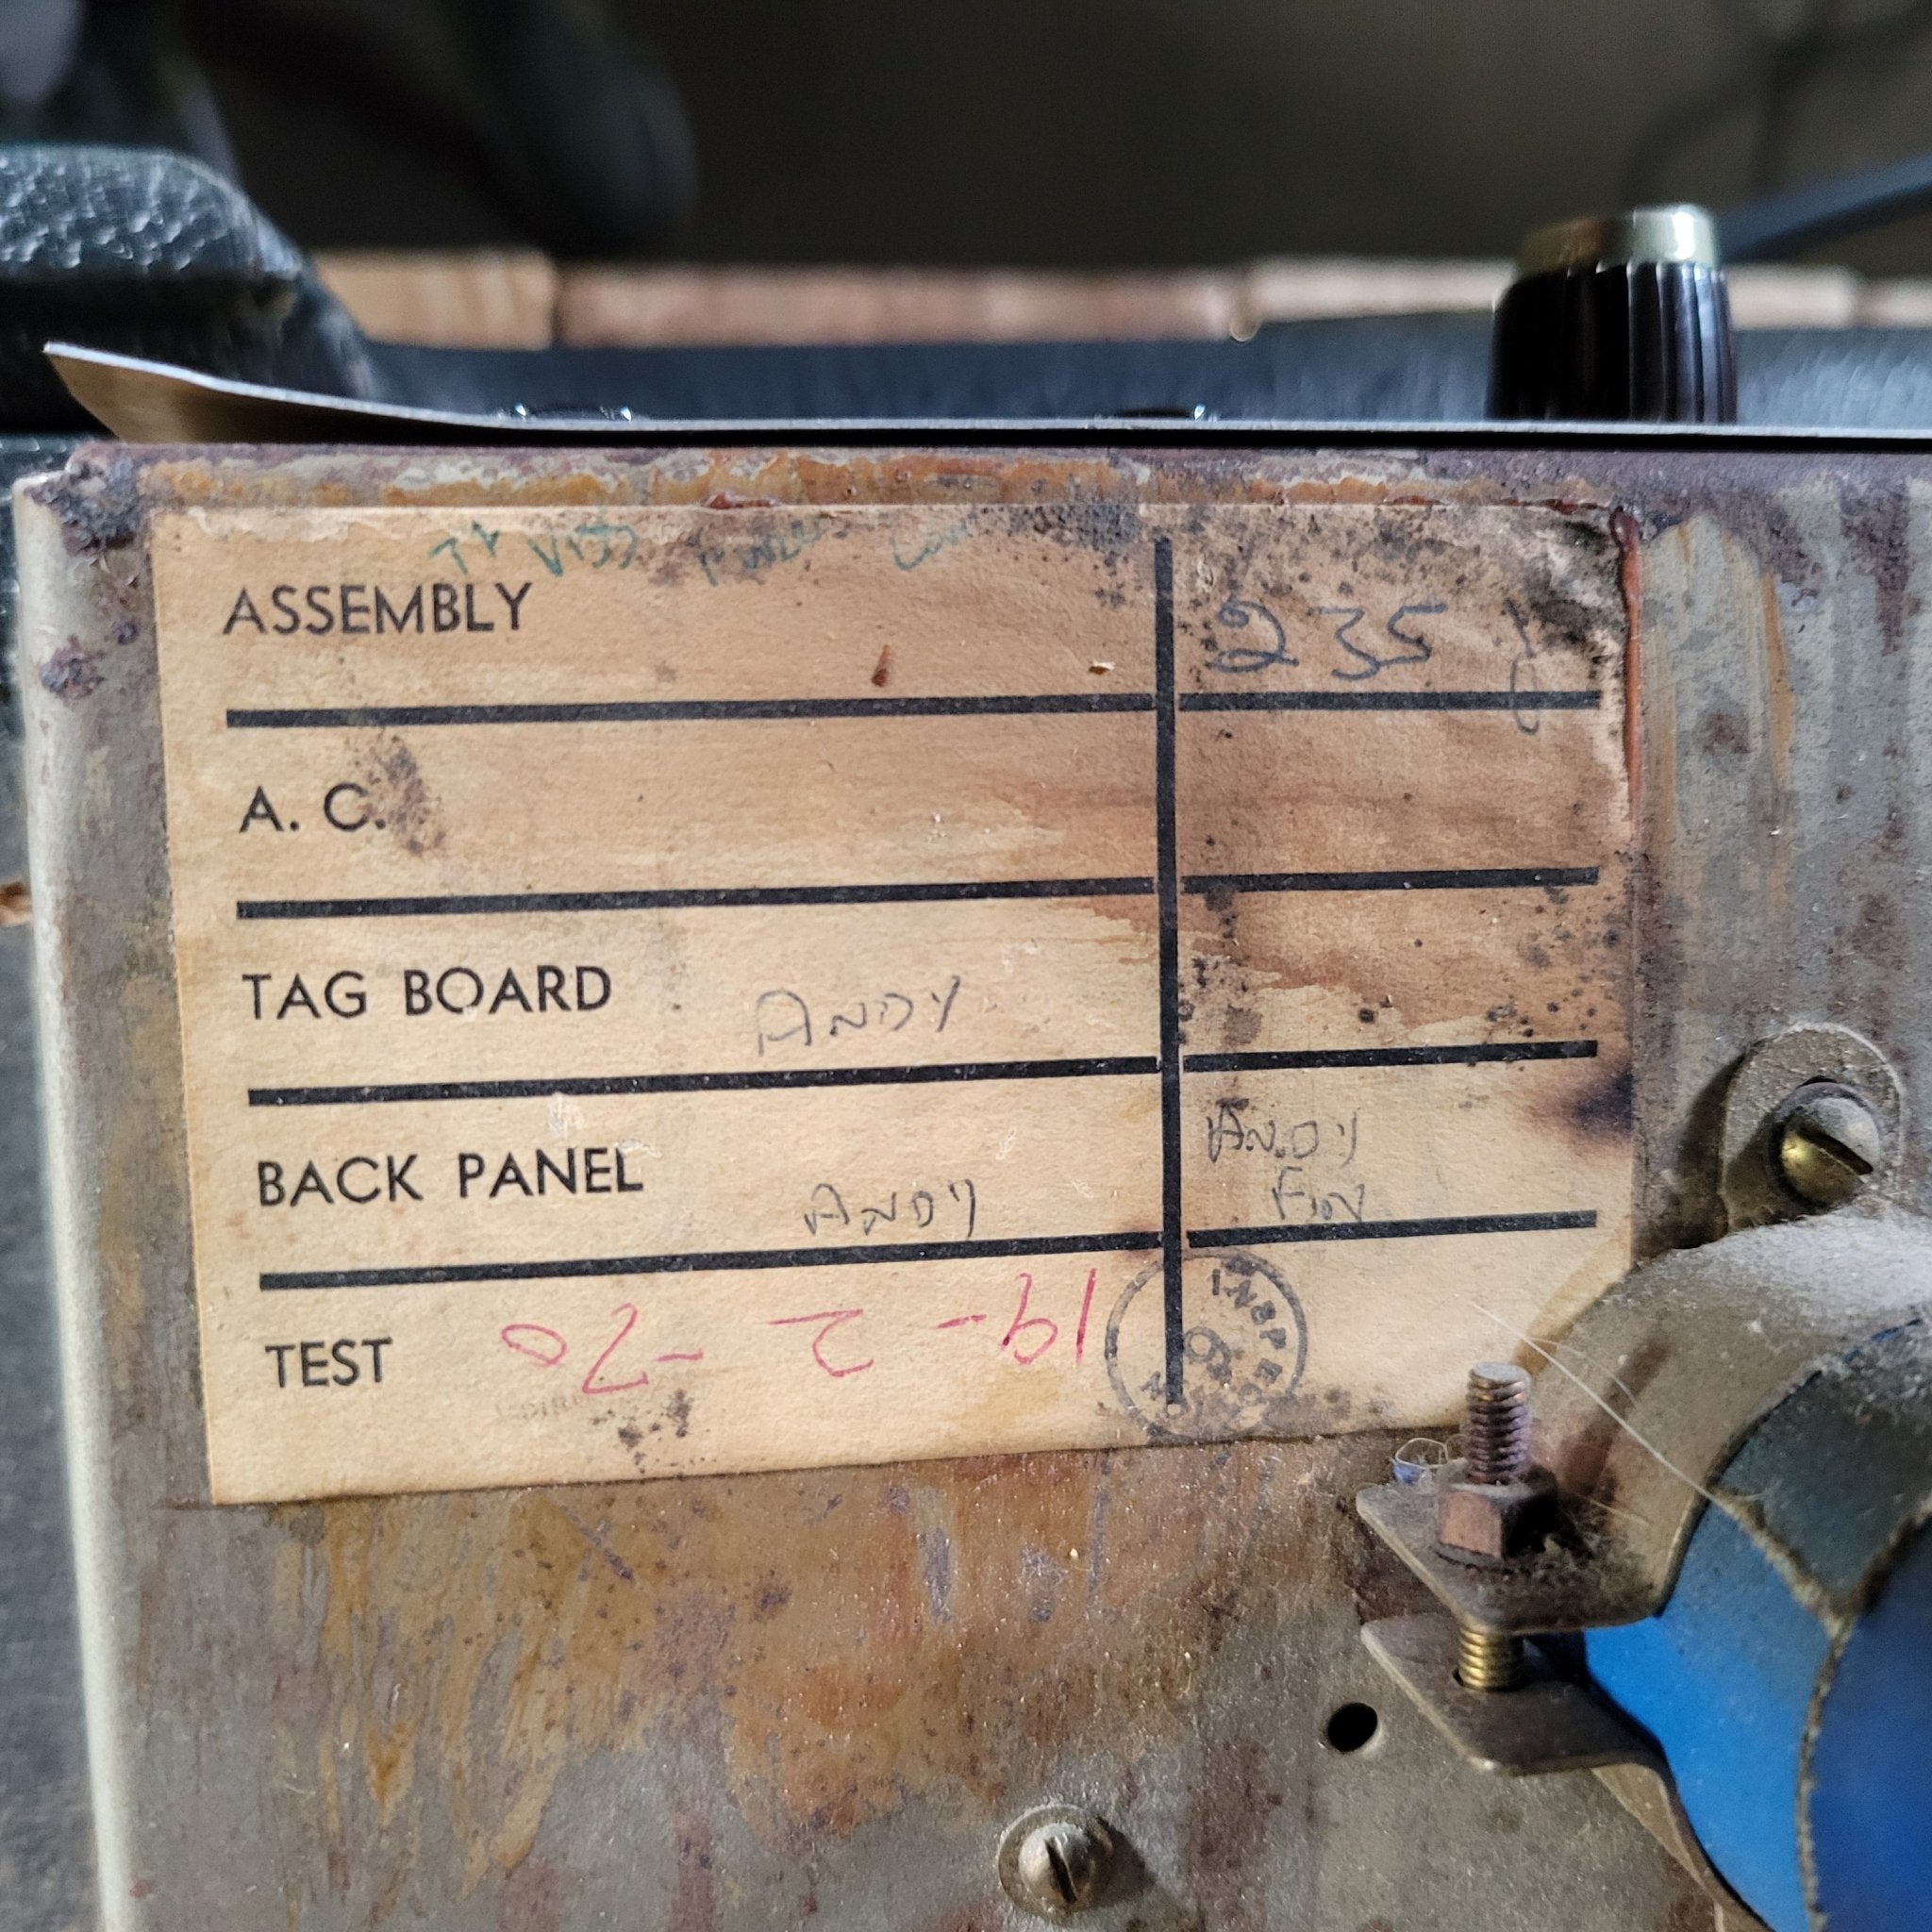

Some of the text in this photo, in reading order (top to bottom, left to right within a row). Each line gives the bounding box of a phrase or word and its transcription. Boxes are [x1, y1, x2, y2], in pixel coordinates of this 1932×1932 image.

[223, 580, 533, 636] ASSEMBLY
[1207, 599, 1448, 681] 235
[240, 782, 387, 833] A. C.
[242, 965, 612, 1021] TAG BOARD
[258, 1147, 643, 1208] BACK PANEL
[265, 1336, 392, 1389] TEST
